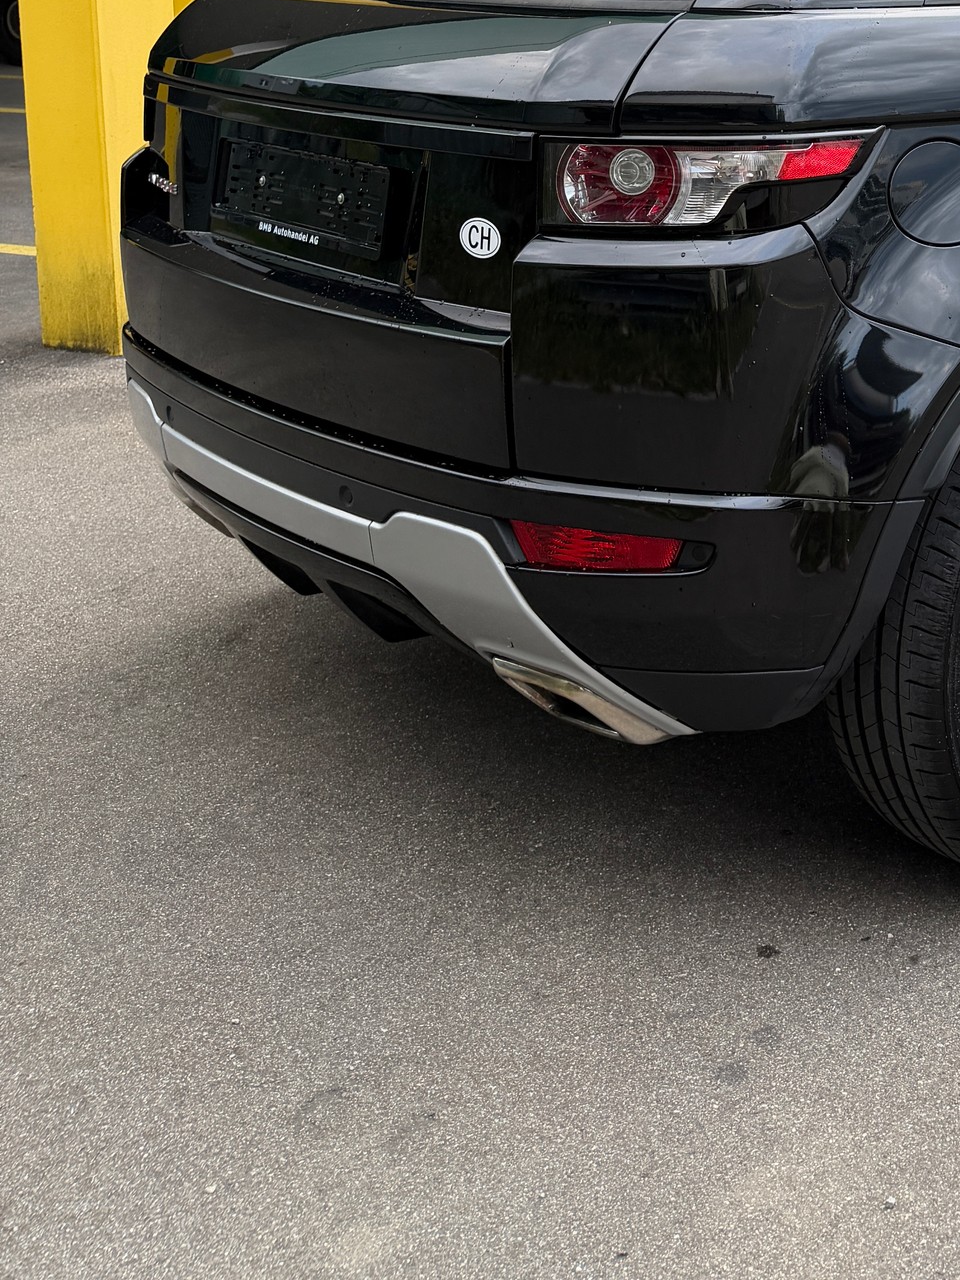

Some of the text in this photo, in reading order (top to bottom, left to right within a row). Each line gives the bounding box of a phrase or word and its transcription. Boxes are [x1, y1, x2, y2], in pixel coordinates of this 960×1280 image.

[272, 225, 309, 243] Autohandel
[308, 234, 320, 246] AG
[468, 224, 492, 252] CH
